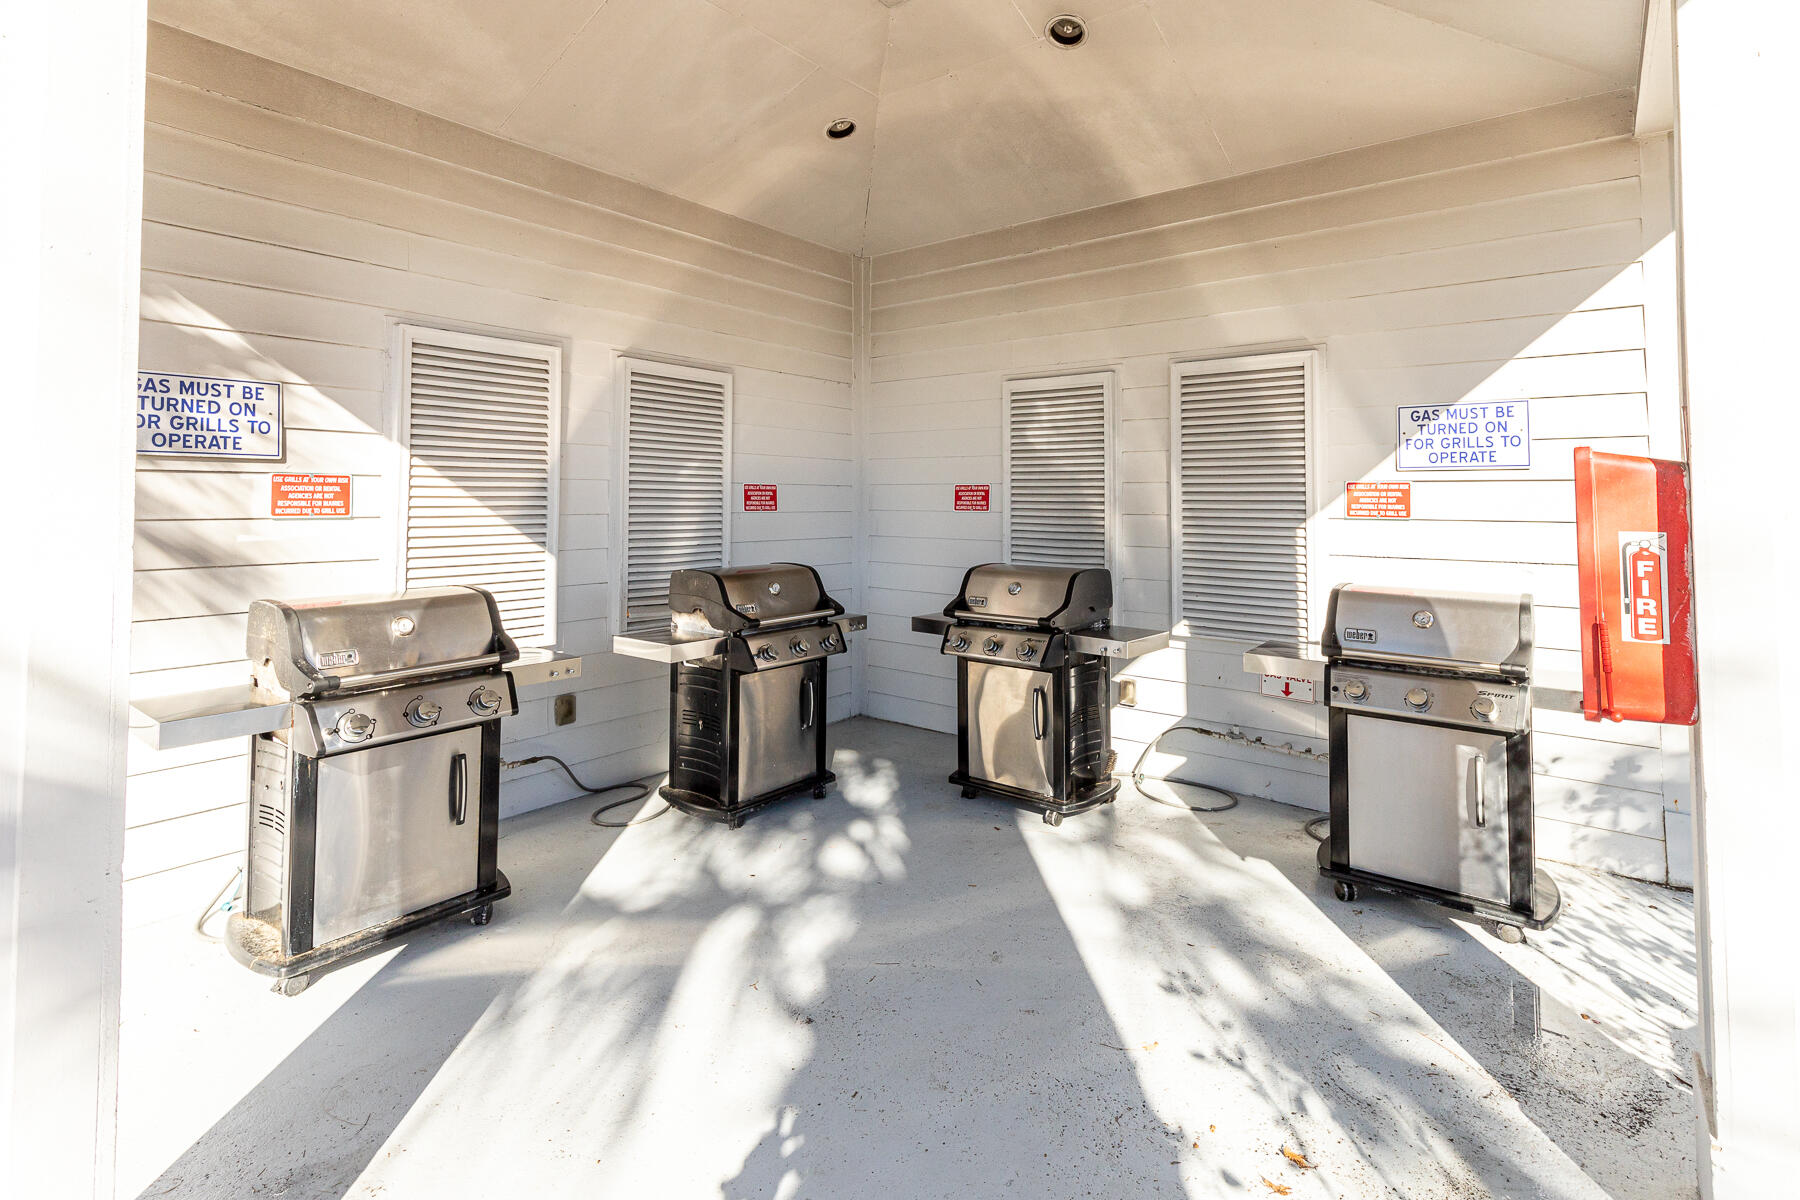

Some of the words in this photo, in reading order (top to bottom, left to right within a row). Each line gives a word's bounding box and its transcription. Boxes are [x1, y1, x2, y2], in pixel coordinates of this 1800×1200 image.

[180, 380, 234, 399] MUST
[242, 386, 264, 401] BE
[138, 396, 221, 414] TURNED
[229, 402, 256, 417] ON
[1410, 409, 1440, 422] GAS
[1446, 407, 1488, 420] MUST
[1496, 406, 1515, 418] BE
[137, 414, 161, 429] OR
[170, 416, 240, 433] GRILLS
[247, 420, 271, 435] TO
[1417, 422, 1478, 435] TURNED
[1485, 421, 1508, 433] ON
[152, 432, 242, 450] OPERATE
[1406, 438, 1434, 450] FOR
[1440, 436, 1494, 449] GRILLS
[1500, 435, 1522, 448] TO
[1428, 450, 1497, 464] OPERATE
[1636, 560, 1658, 636] FIRE
[1346, 629, 1368, 640] weber
[1477, 690, 1516, 700] SPIRIT
